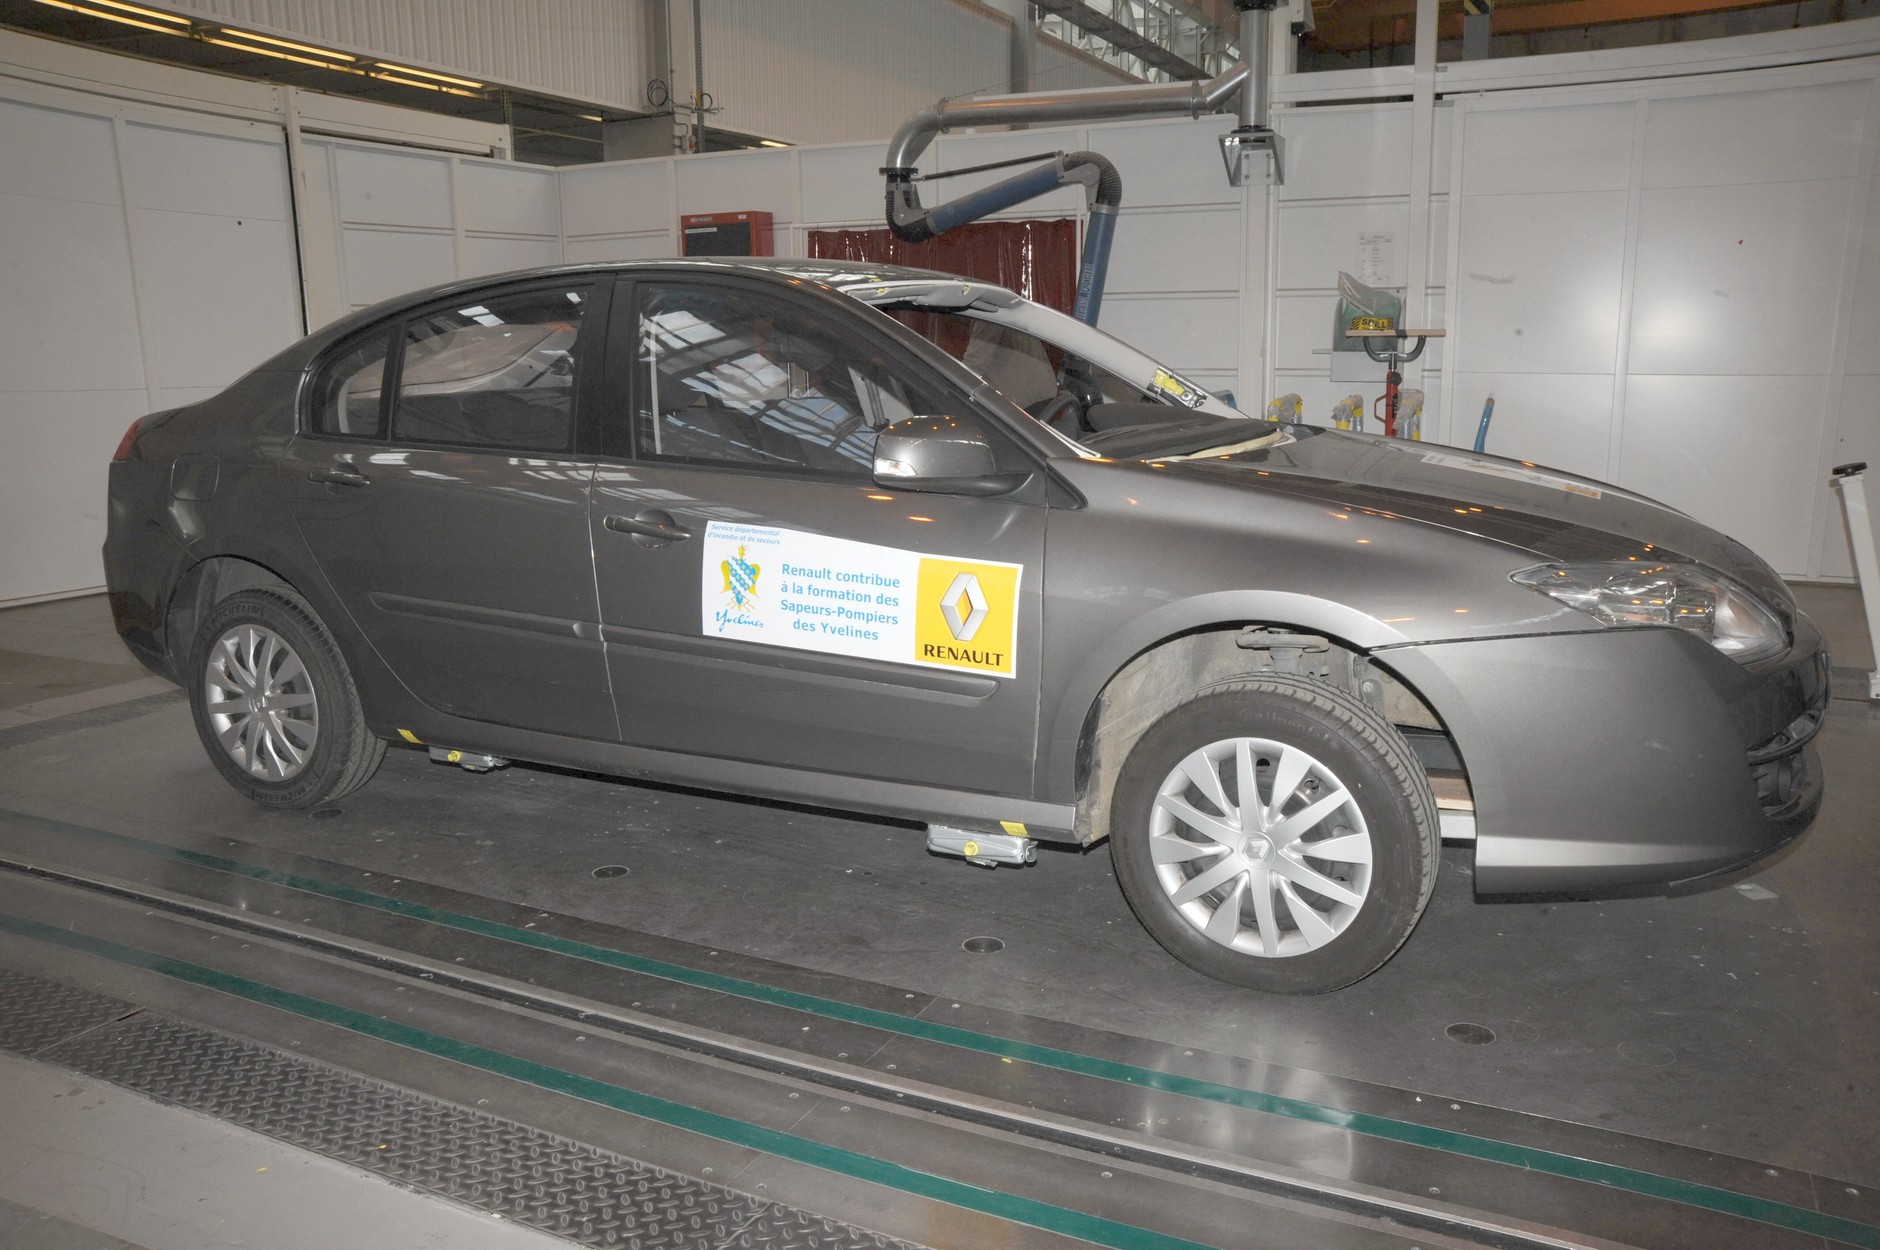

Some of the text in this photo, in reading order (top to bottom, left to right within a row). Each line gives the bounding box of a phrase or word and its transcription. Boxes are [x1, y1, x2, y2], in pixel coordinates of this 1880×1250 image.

[1361, 318, 1387, 329] SPILL
[707, 532, 739, 540] d'incendie
[735, 526, 780, 536] départemental
[782, 563, 900, 588] Renault contribue
[780, 580, 899, 607] à la formation des
[211, 603, 261, 627] MICHELIN
[780, 599, 899, 625] Sapeurs-Pompiers
[793, 619, 879, 641] des Yvelines
[923, 643, 1004, 667] RENAULT
